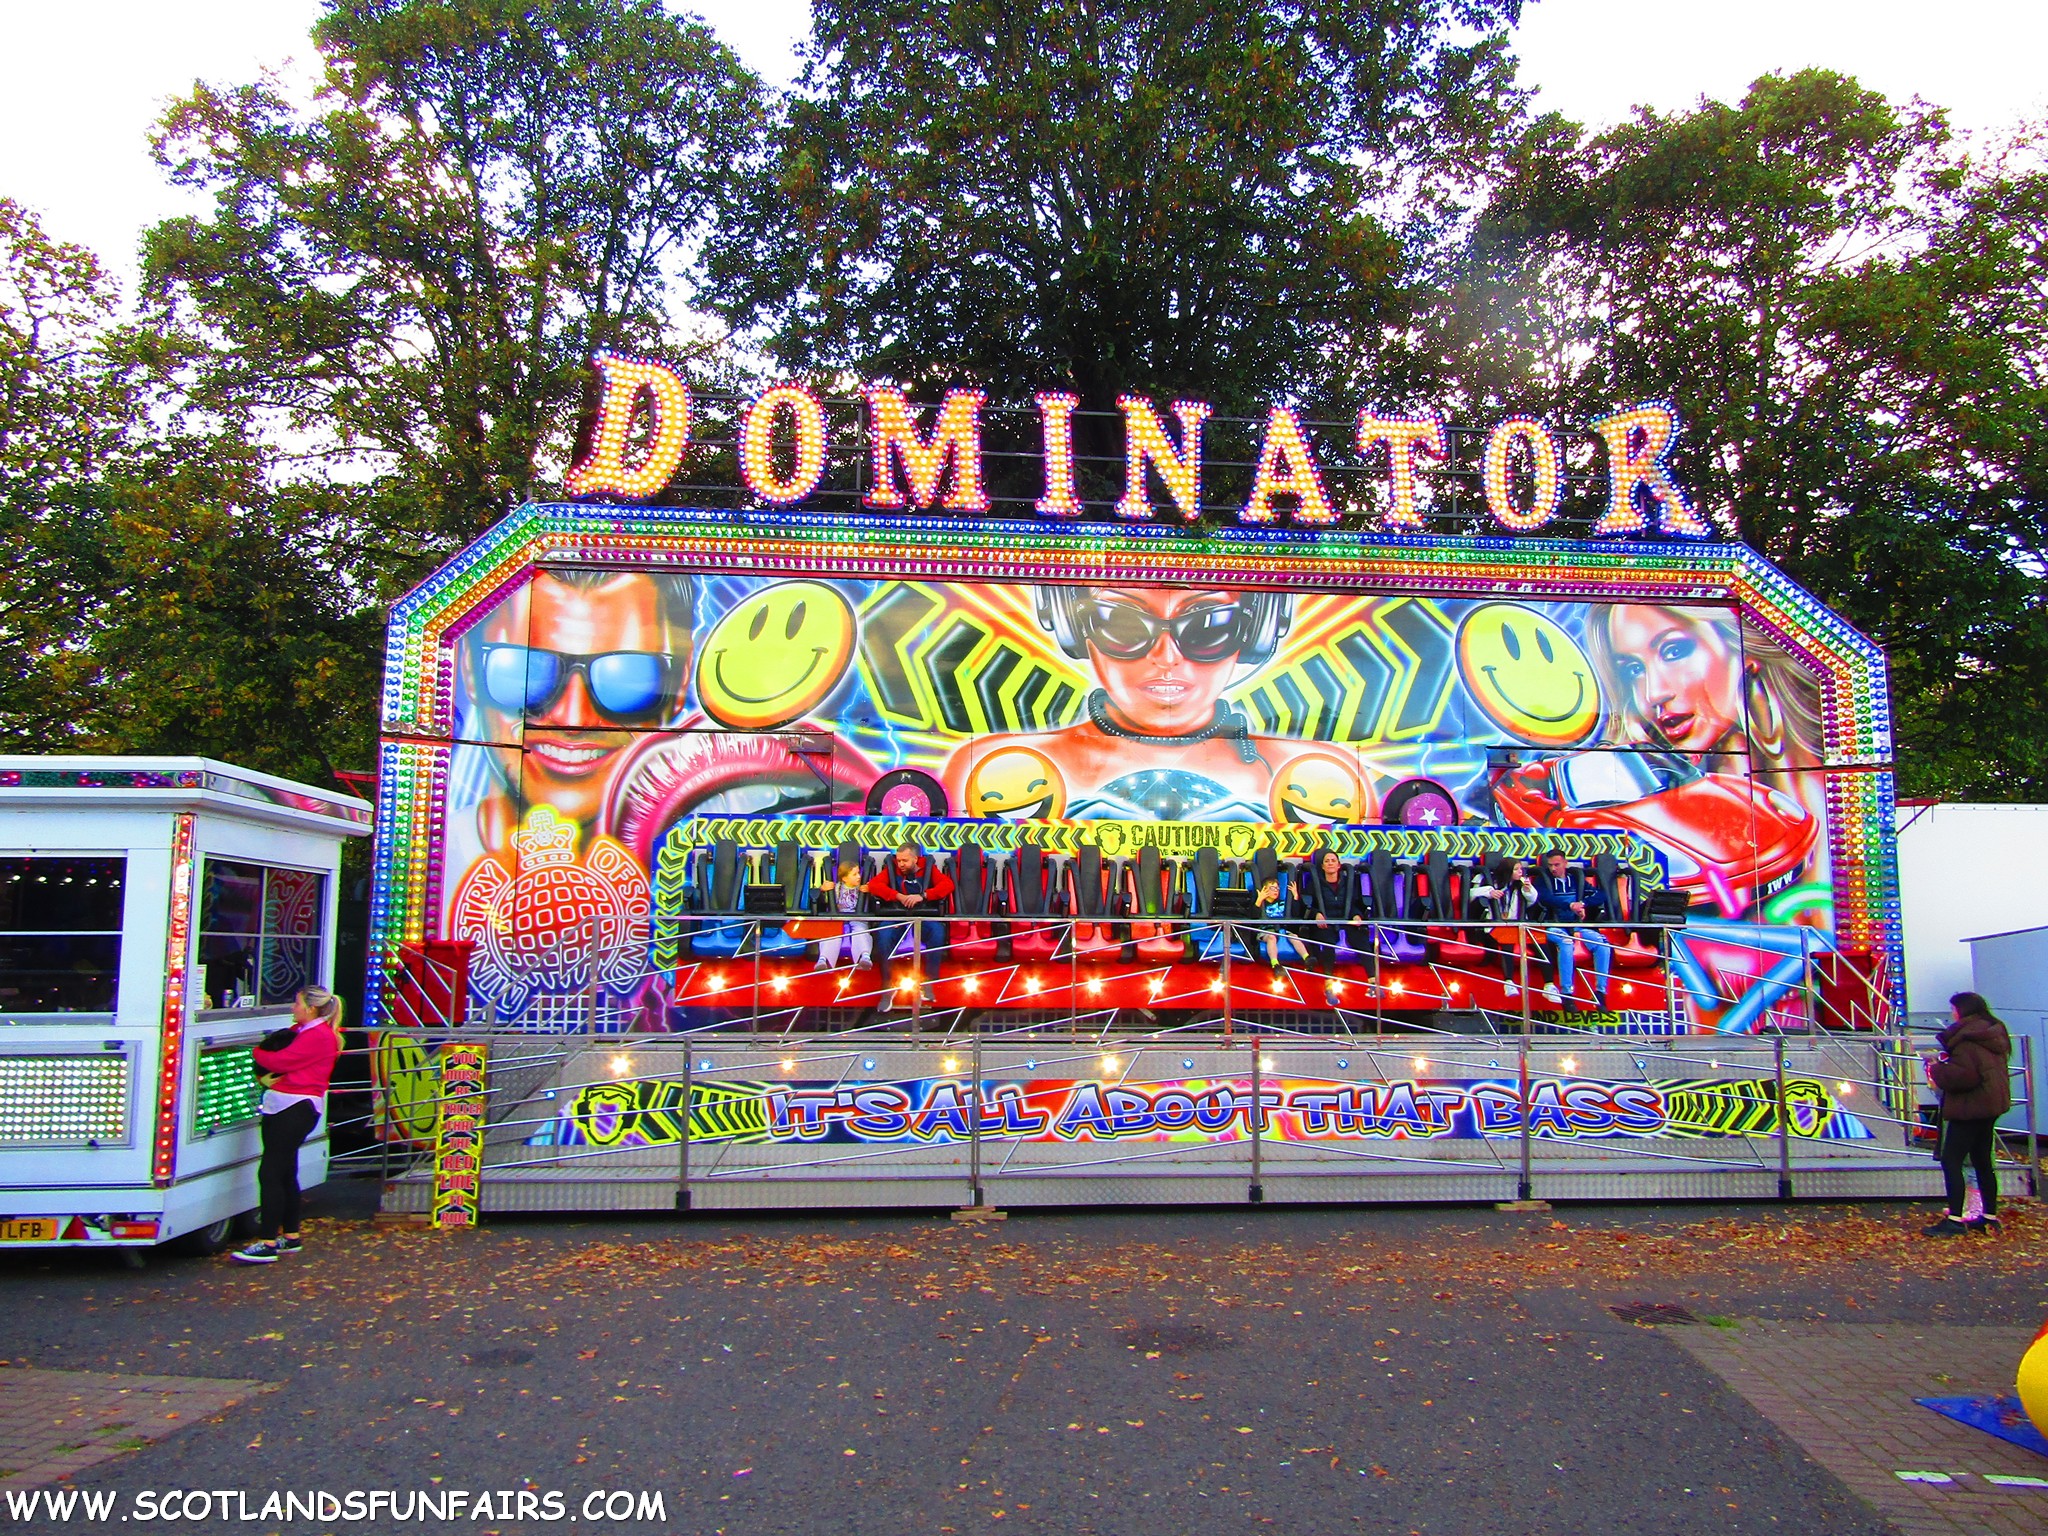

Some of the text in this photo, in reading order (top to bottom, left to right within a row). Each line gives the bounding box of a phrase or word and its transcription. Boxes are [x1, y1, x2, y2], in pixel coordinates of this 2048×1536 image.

[564, 349, 1712, 537] DOMINATOR
[1131, 825, 1220, 847] CAUTION
[452, 1053, 477, 1065] YOU
[445, 1069, 481, 1081] MUST
[443, 1103, 483, 1115] TALLER
[772, 1084, 1665, 1138] IT'S ALL ABOUT THAT BASS
[448, 1137, 472, 1149] THE
[444, 1155, 474, 1170] RED
[440, 1174, 474, 1190] LINE
[449, 1195, 465, 1207] TO
[441, 1211, 469, 1225] RIDE
